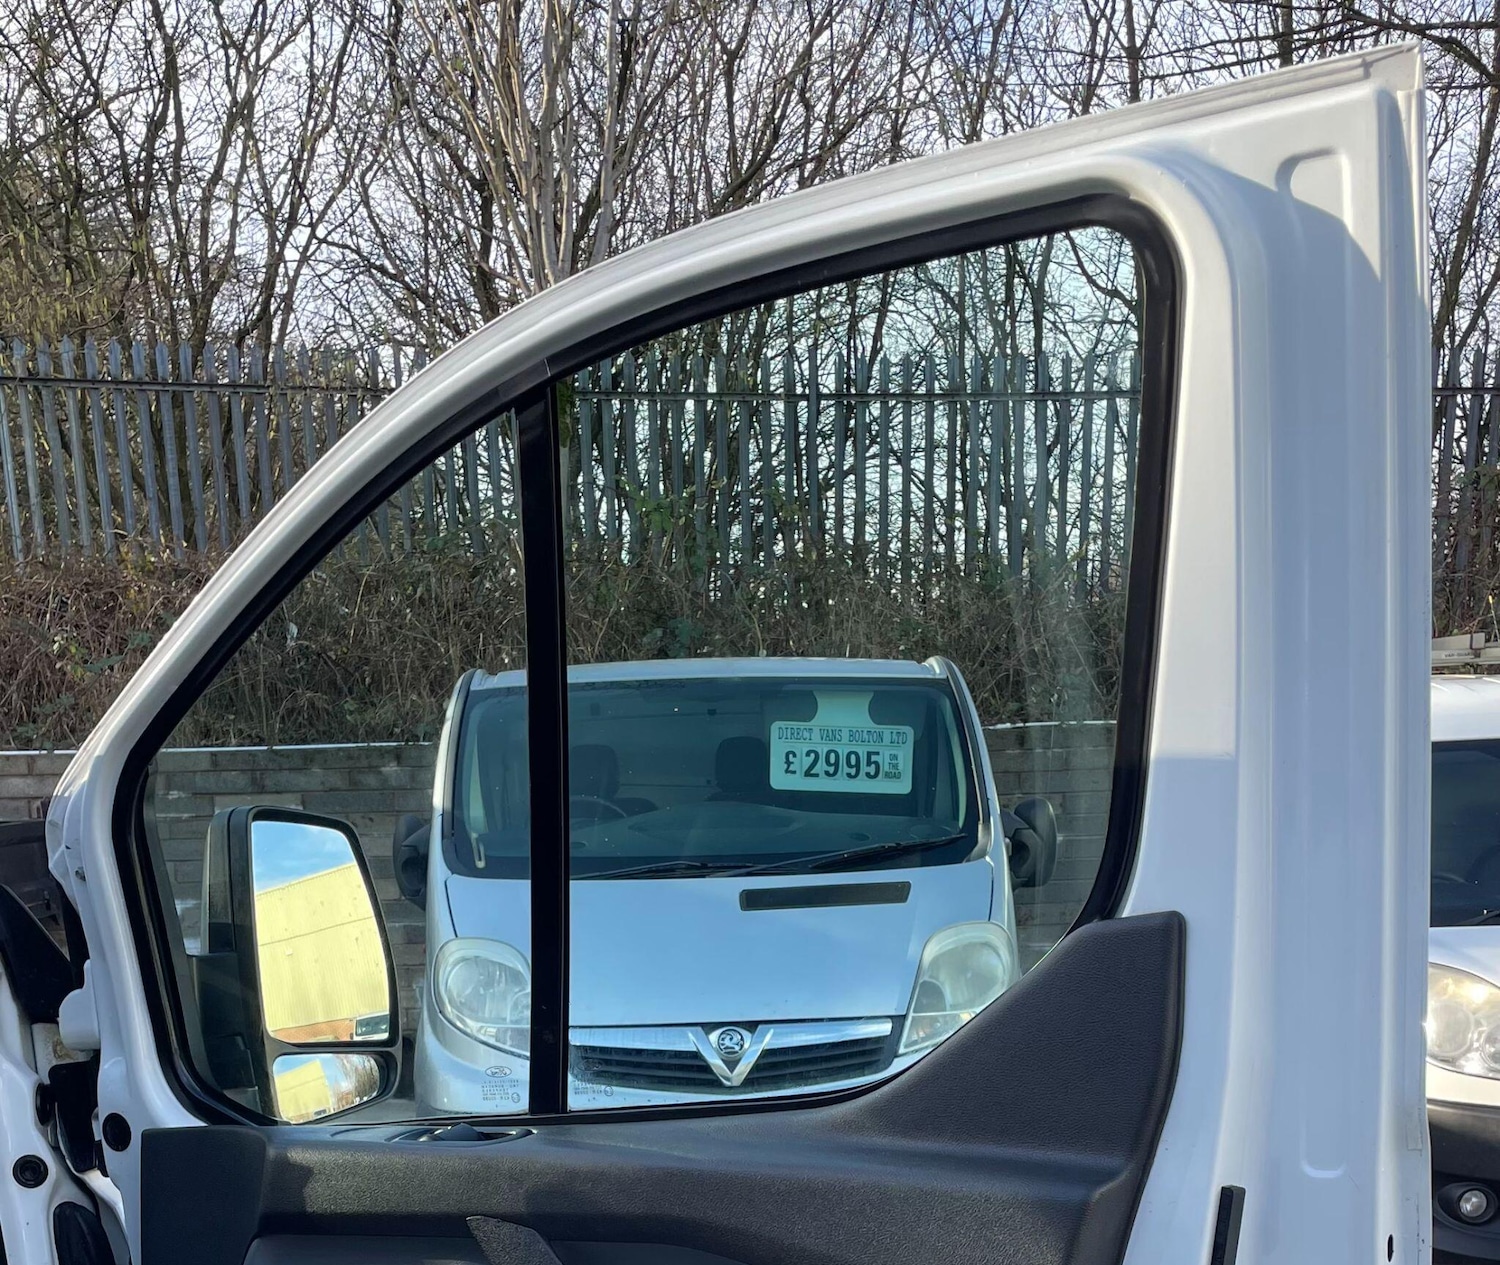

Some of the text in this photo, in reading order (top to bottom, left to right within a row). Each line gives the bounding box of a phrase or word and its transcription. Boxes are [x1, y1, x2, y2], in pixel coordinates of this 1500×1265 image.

[778, 727, 908, 745] DIRECT VANS BOLTON LTD
[889, 753, 899, 761] ON
[888, 762, 899, 770] THE
[884, 771, 902, 779] ROAD
